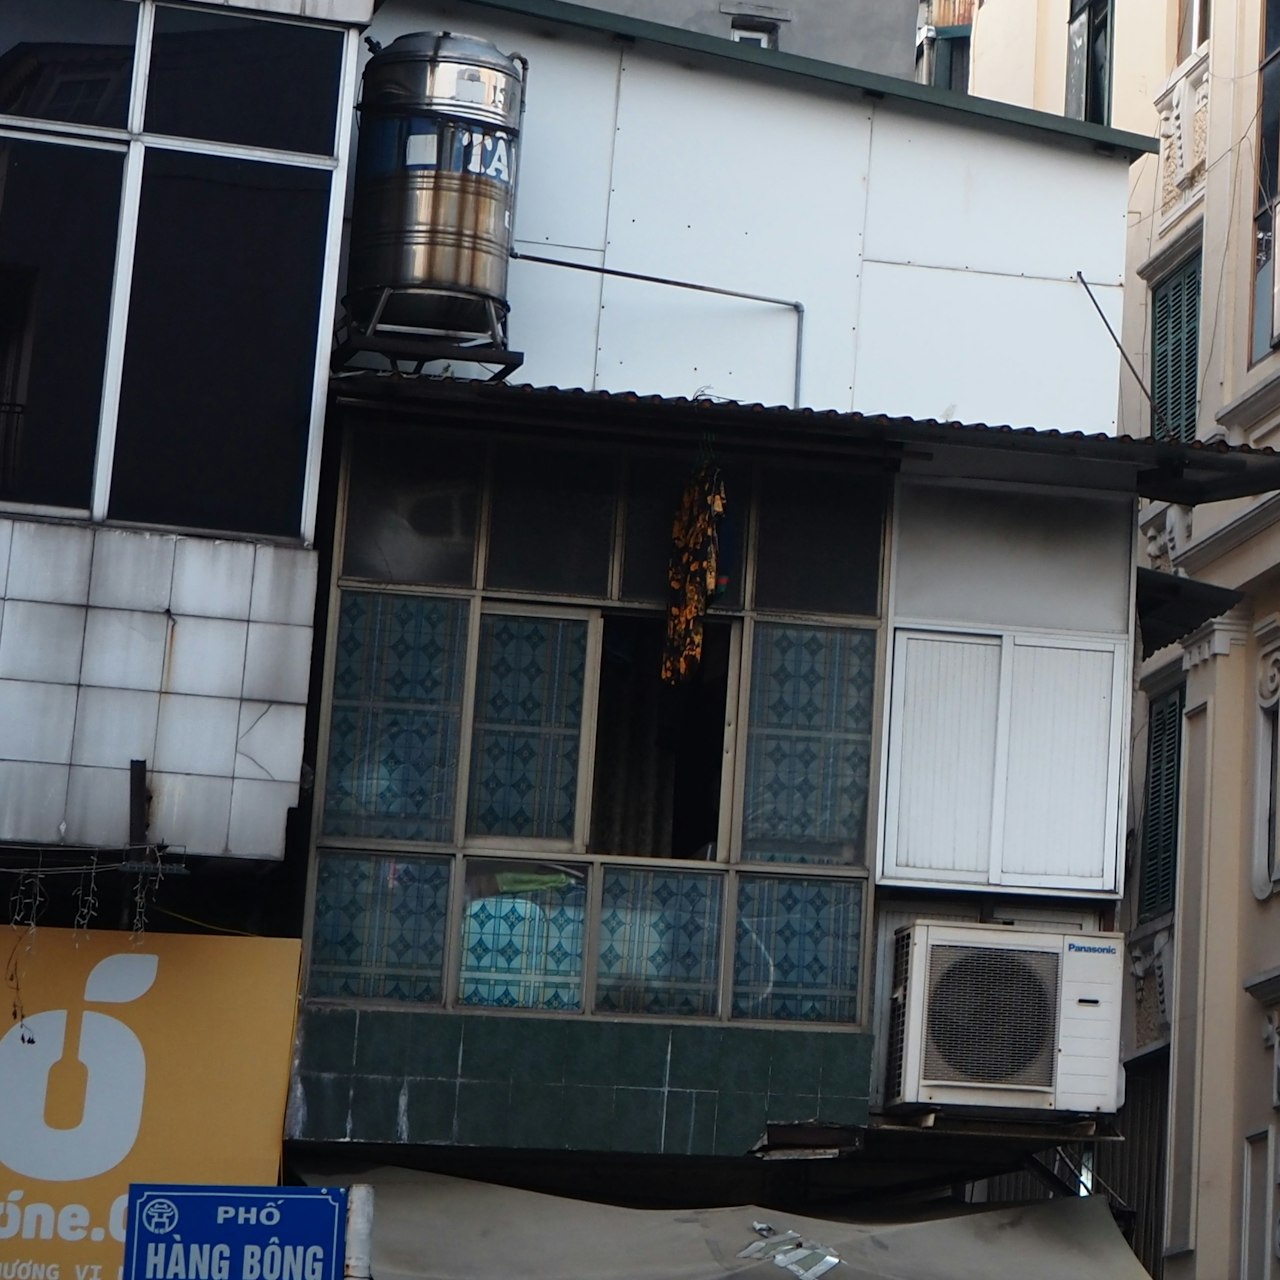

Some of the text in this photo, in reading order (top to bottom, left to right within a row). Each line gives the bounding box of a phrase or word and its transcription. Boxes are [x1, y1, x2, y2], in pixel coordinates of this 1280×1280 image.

[462, 130, 517, 183] TÂ
[1068, 943, 1117, 955] Panasonic
[216, 1199, 285, 1226] PHỐ
[145, 1234, 324, 1280] HÀNG BÔNG
